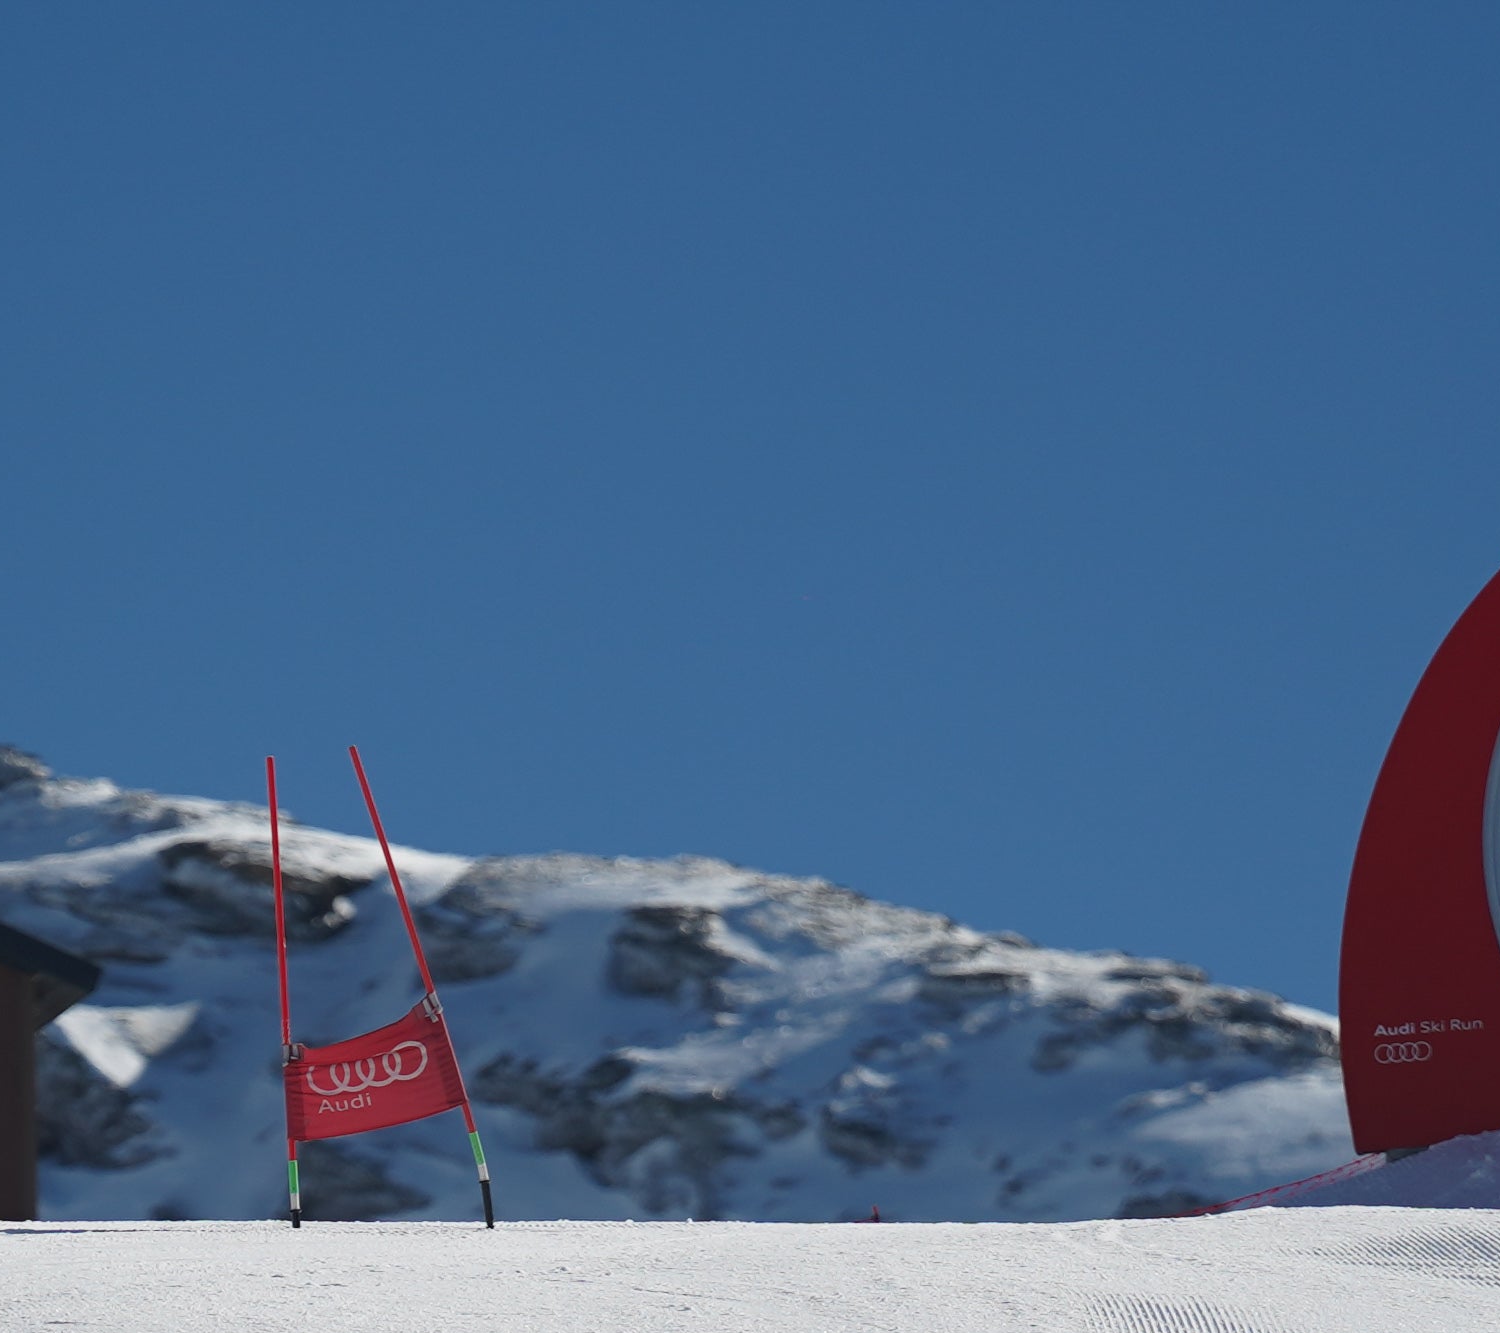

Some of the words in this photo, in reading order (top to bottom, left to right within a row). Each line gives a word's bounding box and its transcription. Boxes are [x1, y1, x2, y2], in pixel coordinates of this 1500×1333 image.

[1374, 1022, 1416, 1037] Audi
[1420, 1020, 1445, 1033] Ski
[1450, 1018, 1484, 1031] Run
[318, 1092, 372, 1114] Audi
